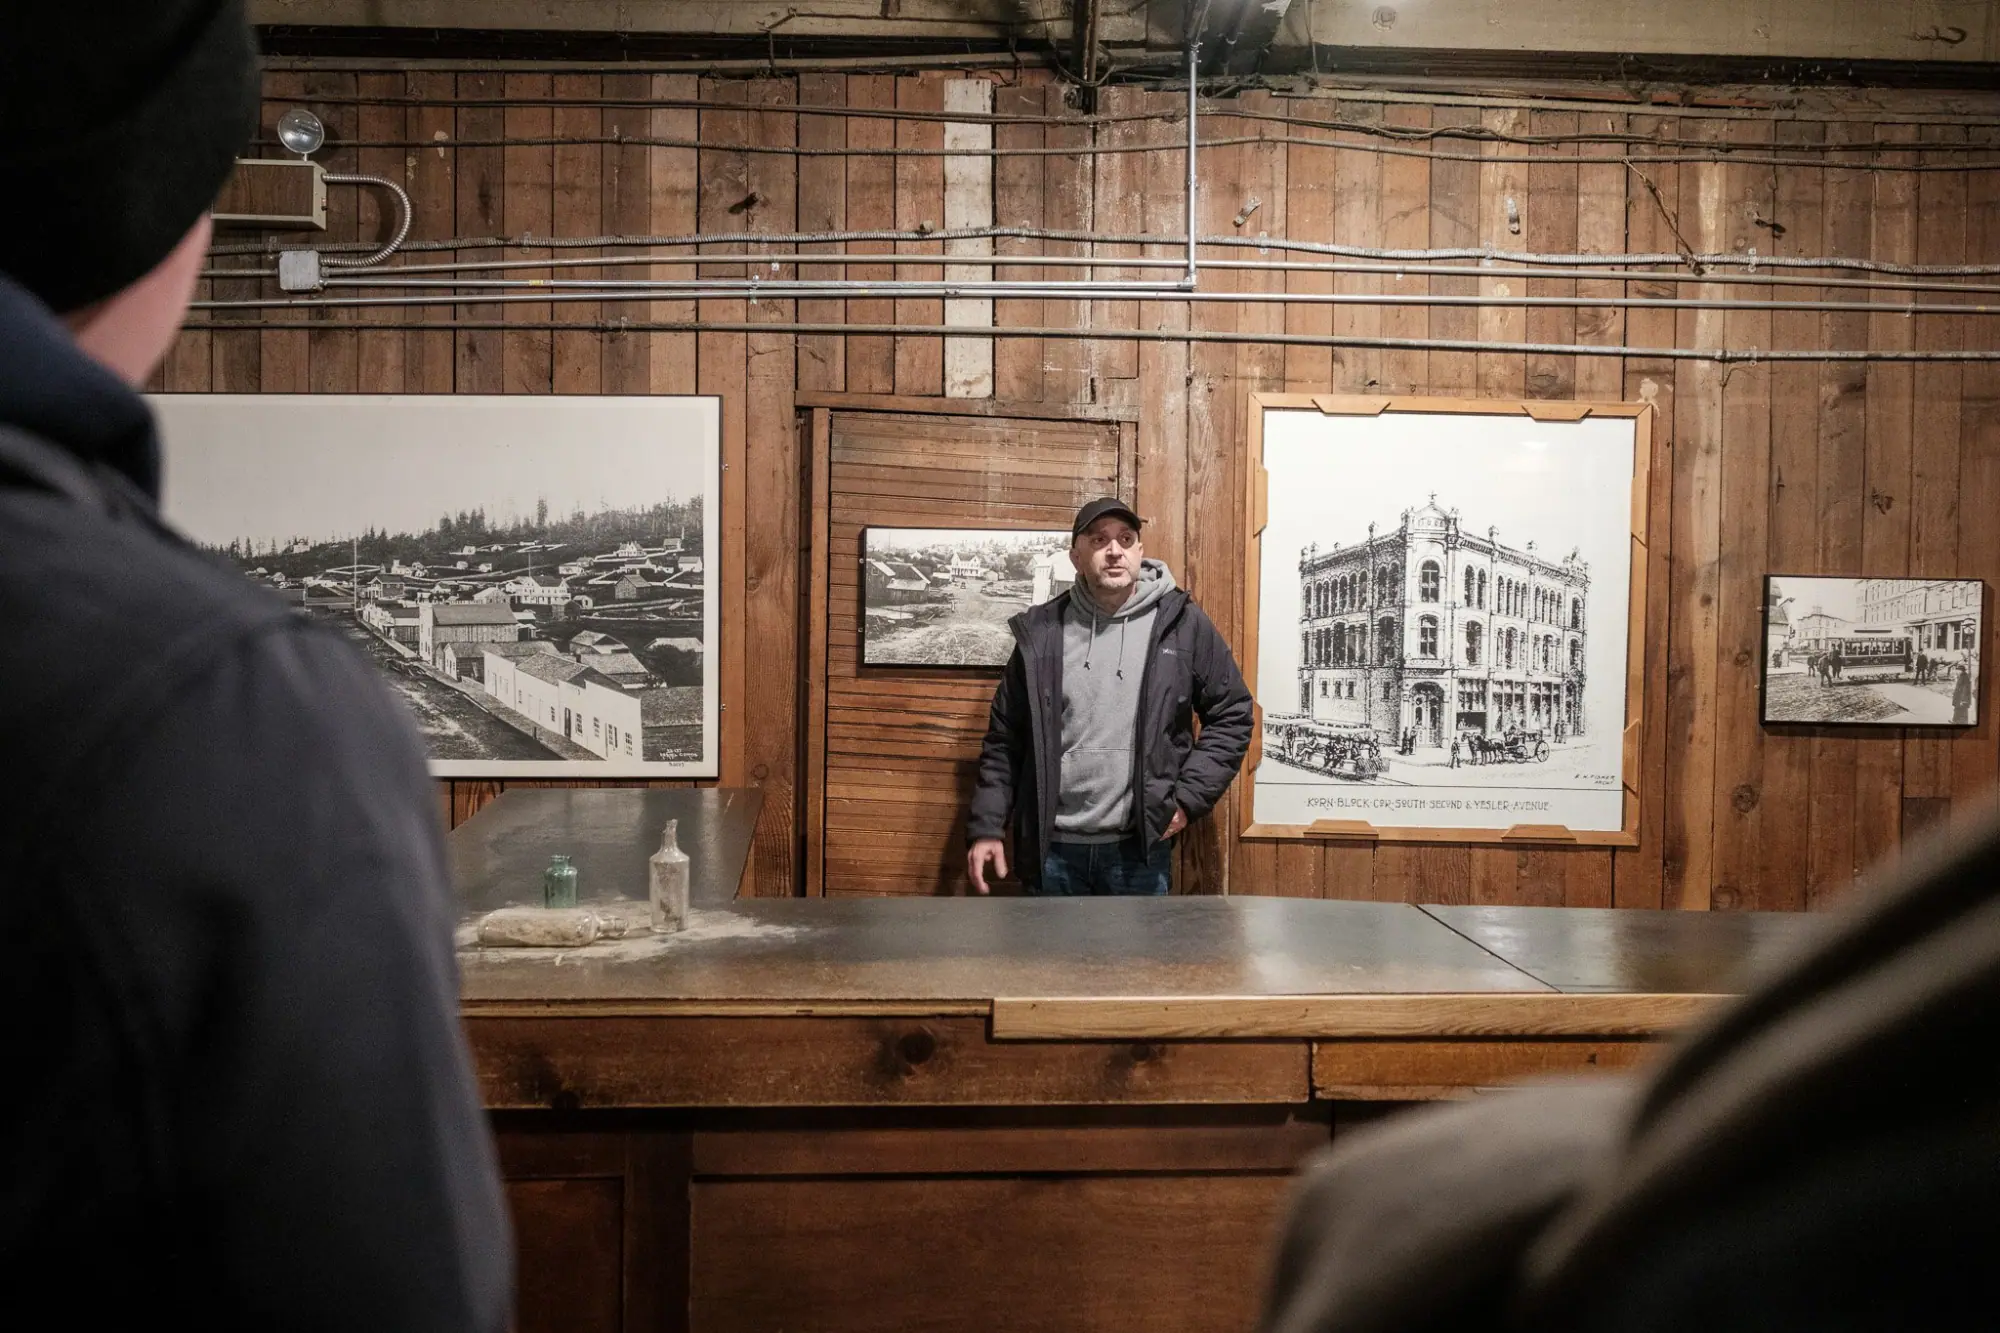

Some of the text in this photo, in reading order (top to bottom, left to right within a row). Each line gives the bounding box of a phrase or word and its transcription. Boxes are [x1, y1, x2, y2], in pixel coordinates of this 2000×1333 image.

[1337, 797, 1370, 808] BLOCK
[1395, 799, 1426, 809] SOUTH
[1429, 800, 1462, 809] SECOND
[1474, 800, 1512, 813] YESLER
[1513, 801, 1549, 811] AVENUE
